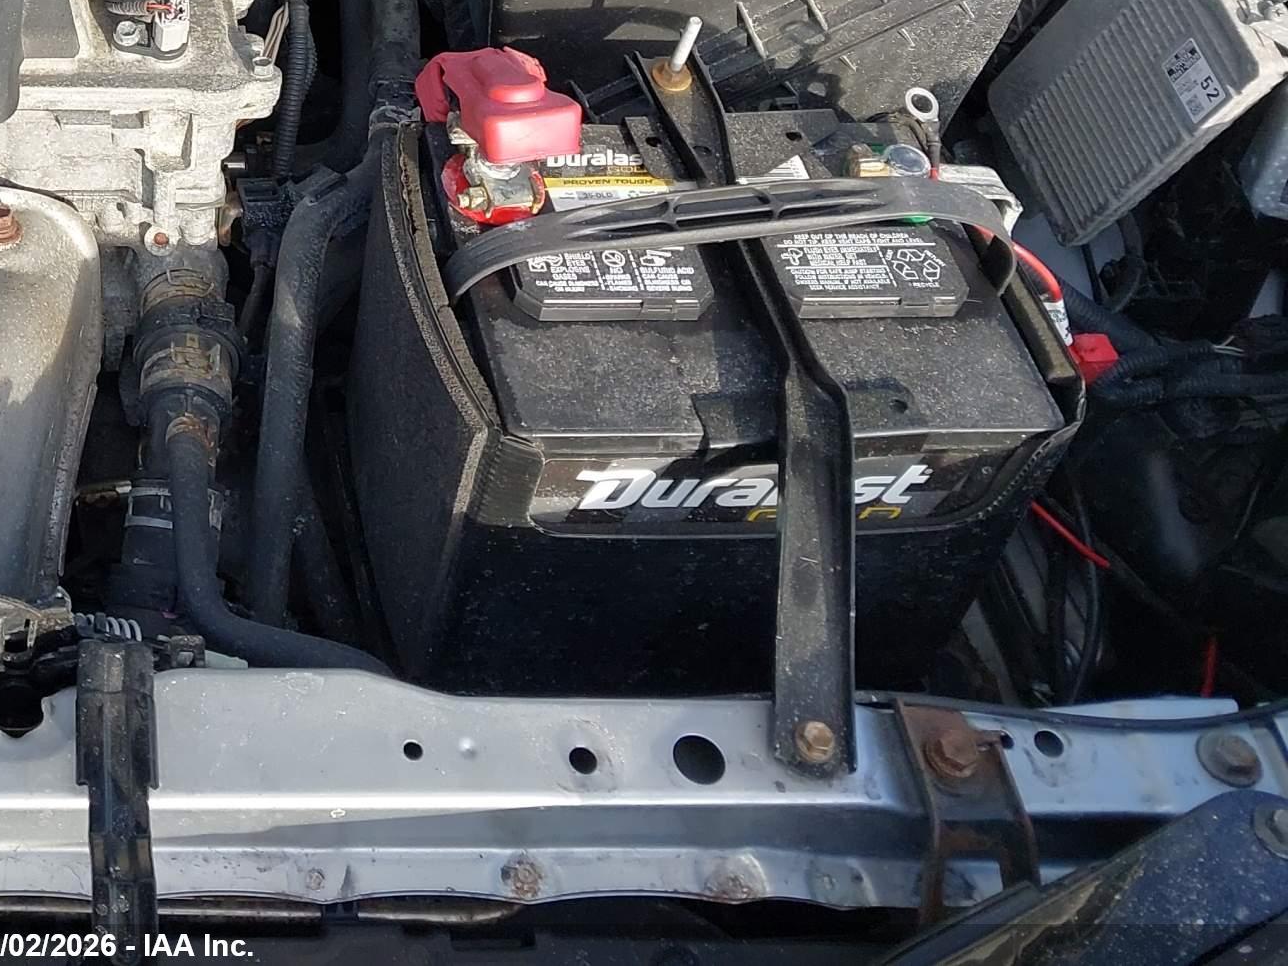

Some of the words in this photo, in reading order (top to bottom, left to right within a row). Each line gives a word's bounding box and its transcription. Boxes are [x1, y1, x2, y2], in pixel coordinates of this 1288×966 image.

[1200, 75, 1220, 103] 52
[547, 148, 644, 167] Duralas
[575, 464, 931, 511] Durast
